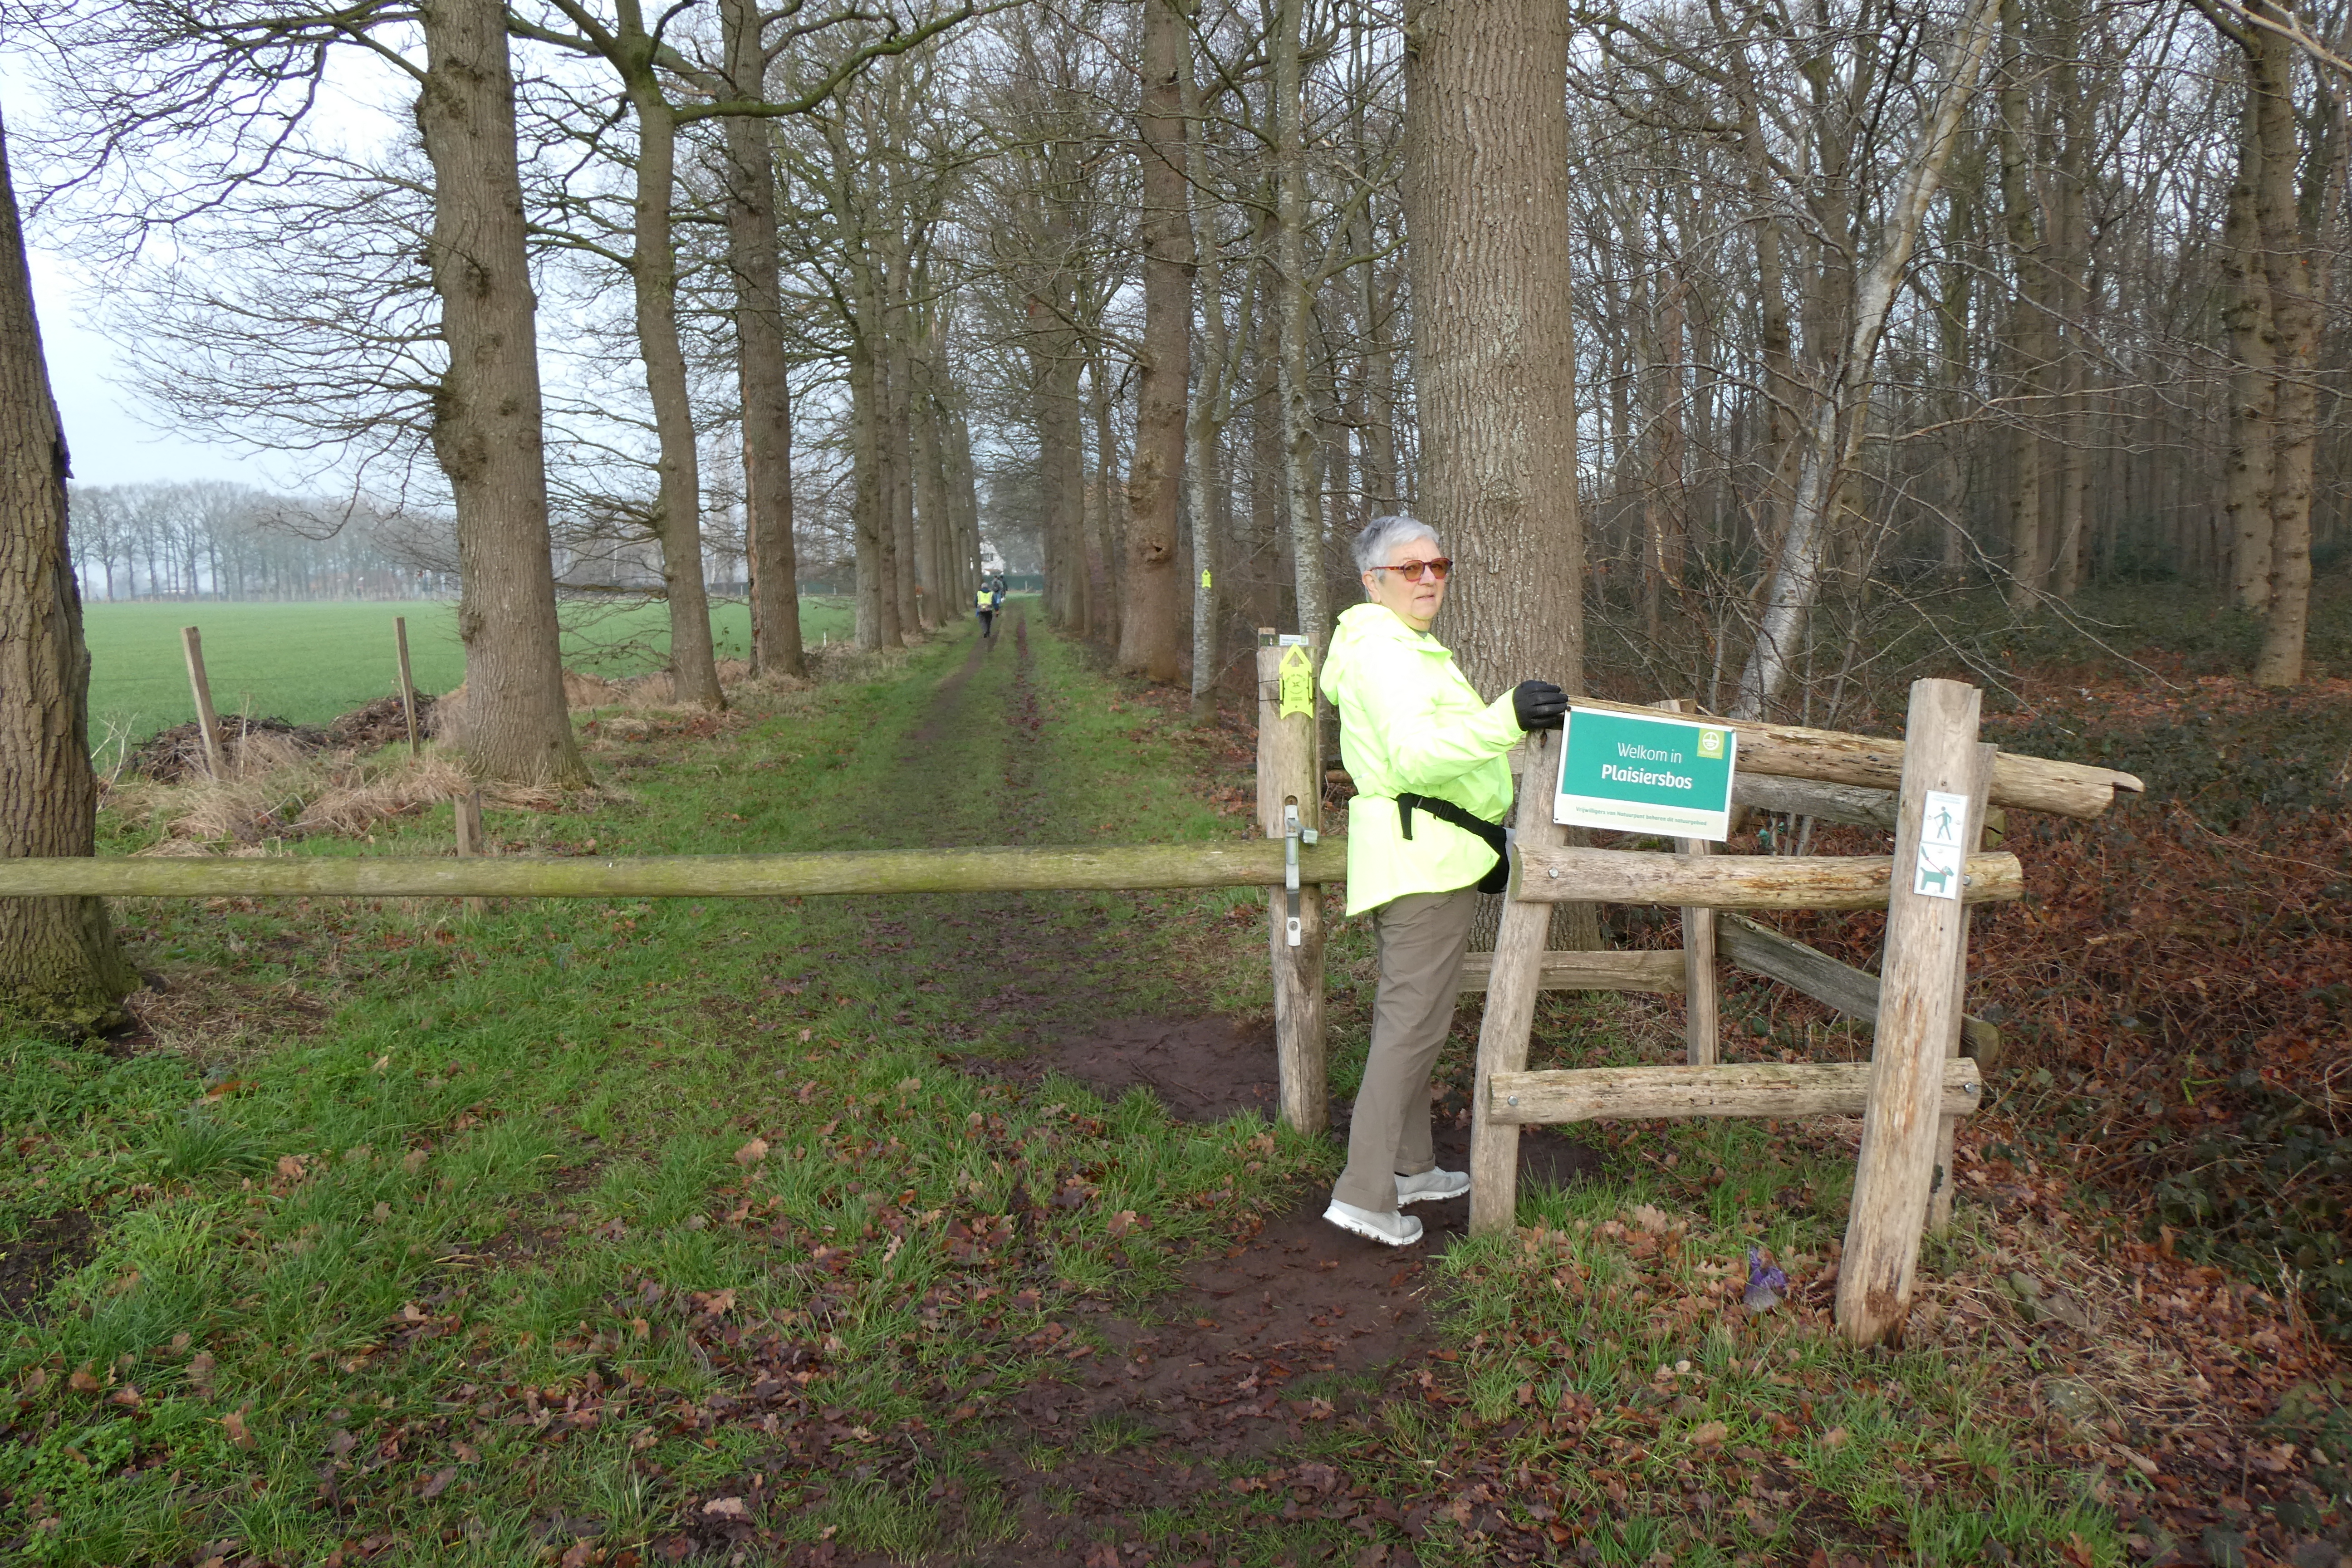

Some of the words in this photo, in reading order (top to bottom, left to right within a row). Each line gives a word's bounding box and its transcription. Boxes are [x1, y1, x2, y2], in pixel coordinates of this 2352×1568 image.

[1617, 742, 1667, 762] Welkom
[1671, 749, 1682, 764] in
[1601, 764, 1693, 789] Plaisiersbos
[1576, 806, 1606, 815] Vrijwilligers
[1617, 811, 1645, 819] Natuurpunt
